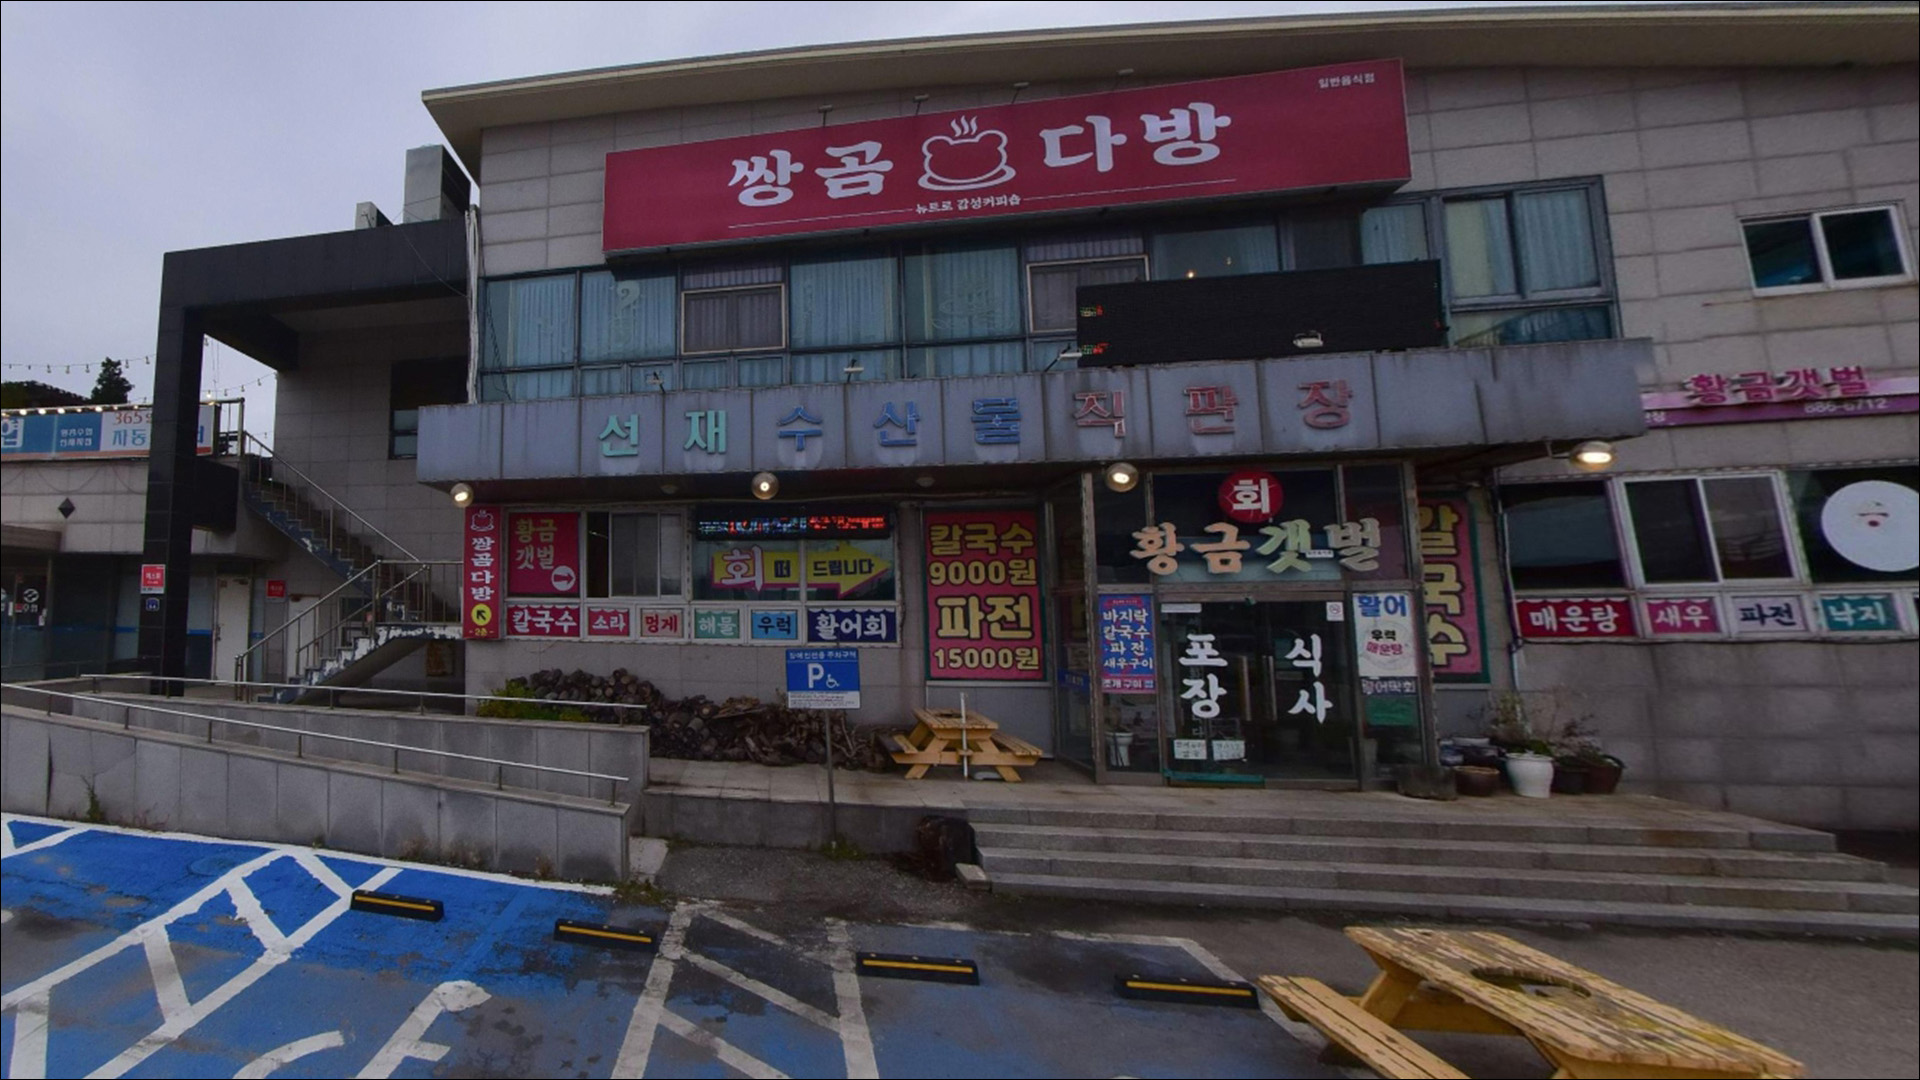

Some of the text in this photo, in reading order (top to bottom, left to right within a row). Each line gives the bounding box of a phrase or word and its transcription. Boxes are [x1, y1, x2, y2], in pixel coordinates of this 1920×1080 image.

[727, 102, 1231, 207] 쌍곰 다방
[916, 194, 1021, 214] 뉴트로 감성커피숍
[1689, 366, 1868, 404] 황금갯벌
[599, 379, 1352, 457] 선재 수산물 직판장
[1232, 479, 1270, 513] 회
[516, 519, 557, 543] 황금
[930, 523, 1034, 556] 칼국수
[516, 545, 555, 570] 갯벌
[1130, 518, 1381, 575] 황금갯벌
[471, 536, 495, 600] 쌍곰다방
[721, 544, 875, 592] 회 떠 드립니다
[929, 558, 1037, 586] 9000원
[937, 595, 1032, 640] 파전
[1103, 608, 1148, 624] 바지락
[1358, 596, 1407, 617] 활어
[1655, 607, 1710, 627] 새우
[1738, 604, 1797, 627] 파전
[1828, 605, 1885, 627] 낙지
[512, 610, 577, 633] 칼국수
[592, 614, 626, 632] 소라
[645, 615, 680, 634] 멍게
[698, 615, 737, 636] 해물
[758, 615, 791, 635] 우럭
[815, 613, 887, 641] 활어회
[1103, 625, 1150, 640] 칼국수
[934, 646, 1039, 671] 15000원
[1104, 657, 1153, 669] 새우구이
[808, 663, 824, 688] P
[1179, 633, 1228, 718] 포장
[1285, 633, 1333, 724] 식사
